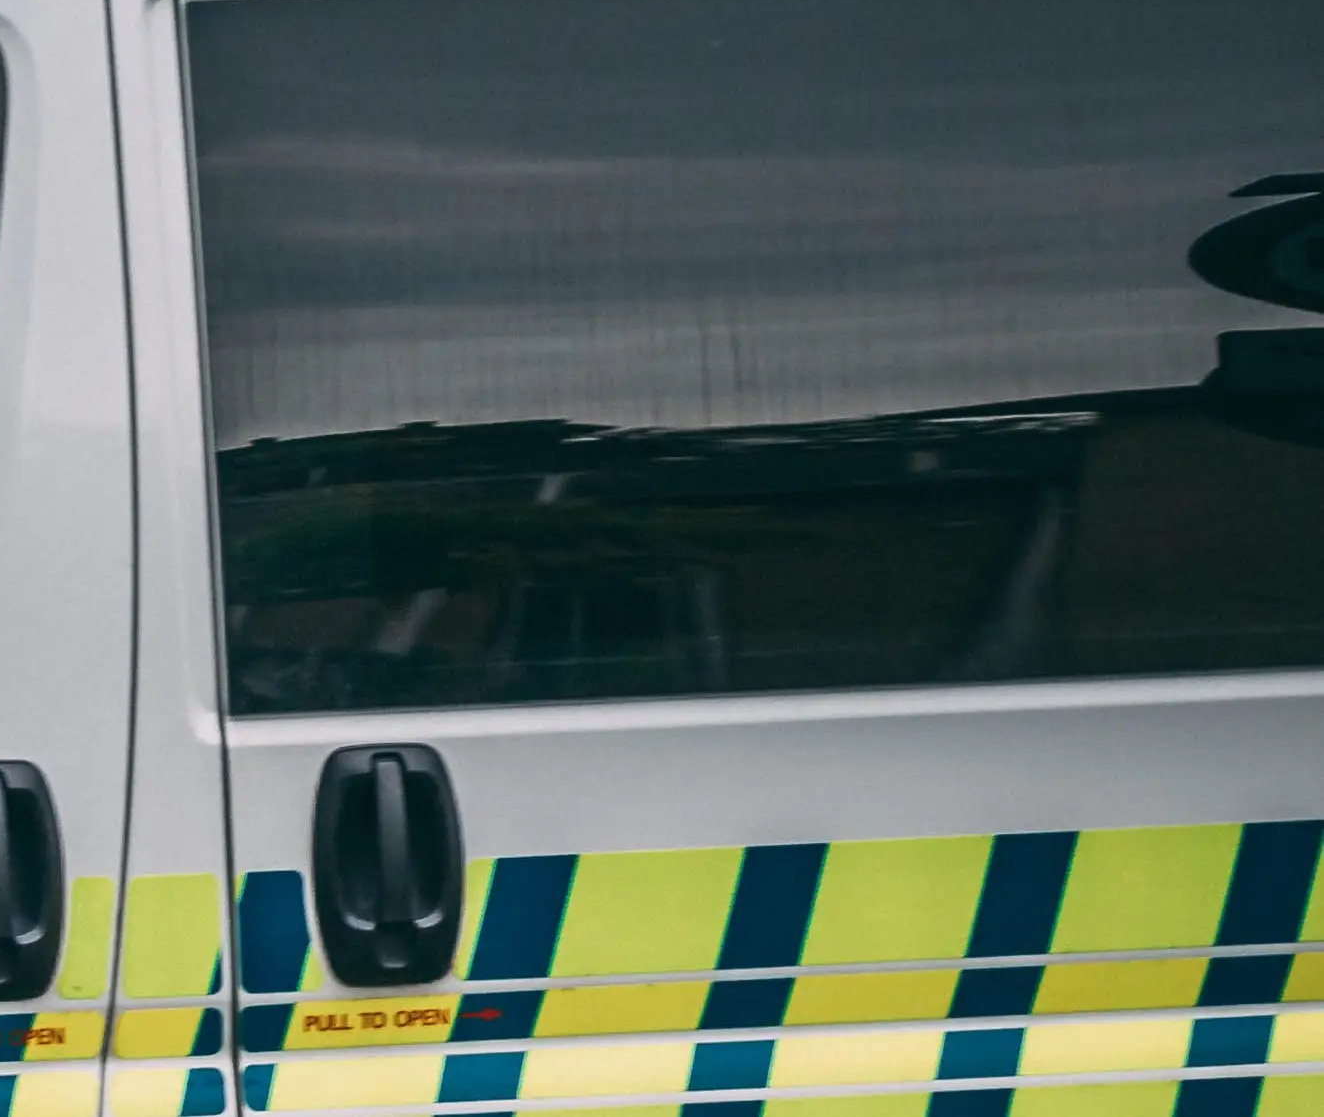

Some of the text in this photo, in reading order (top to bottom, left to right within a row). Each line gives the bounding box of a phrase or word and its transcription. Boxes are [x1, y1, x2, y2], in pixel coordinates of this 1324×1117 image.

[303, 1008, 451, 1032] PULL TO OPEN
[9, 1027, 66, 1047] OPEN
